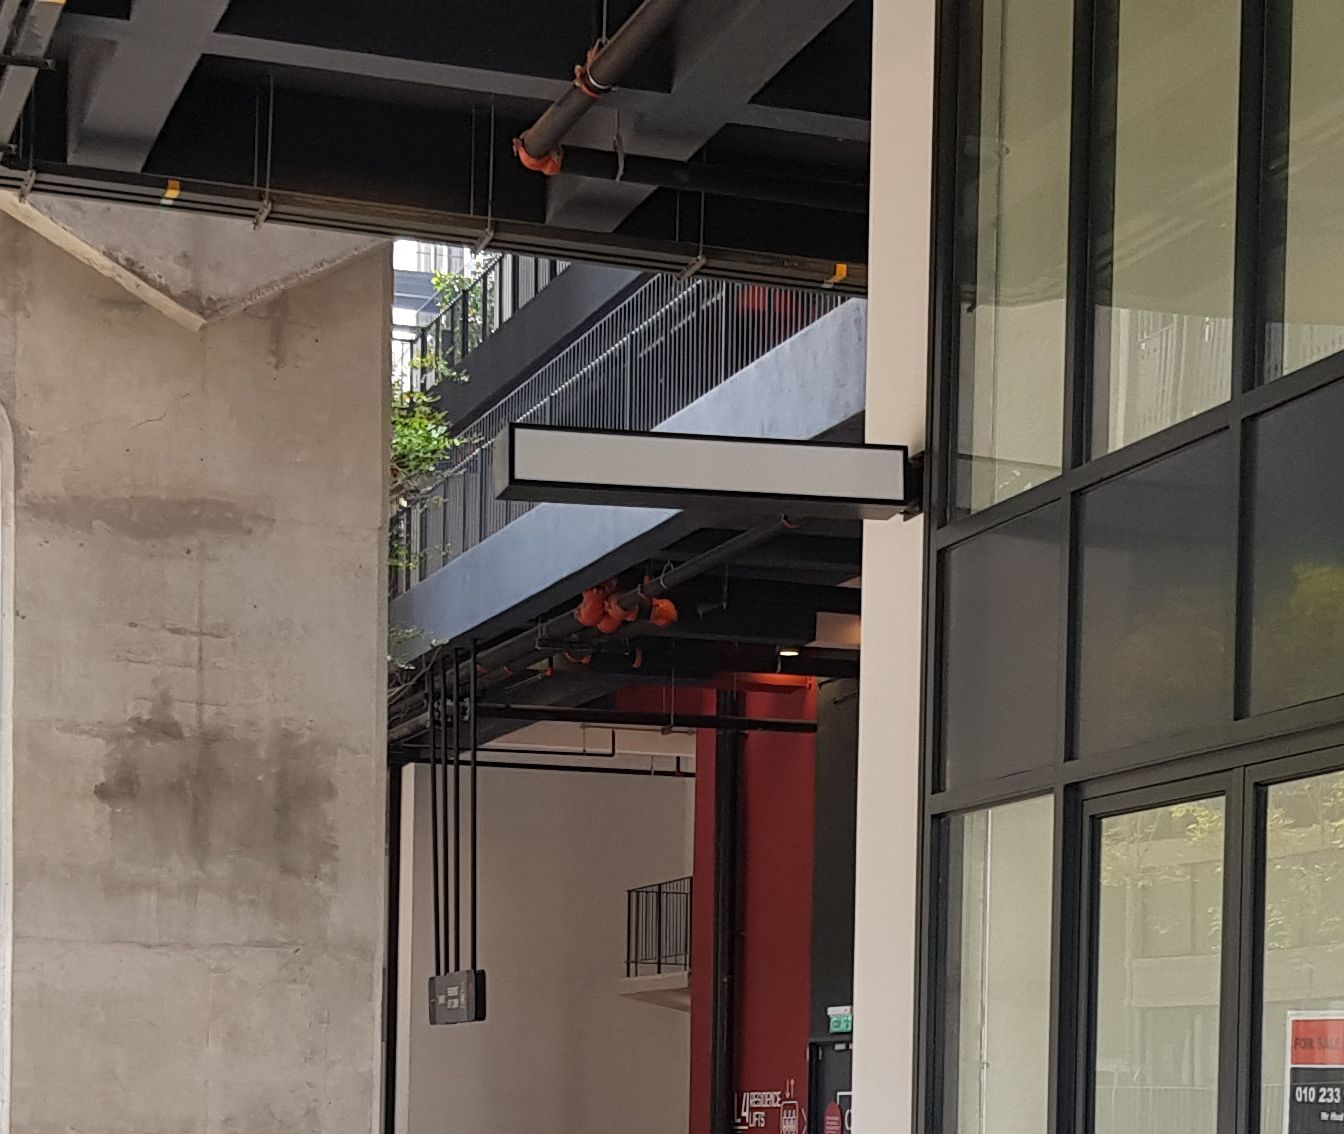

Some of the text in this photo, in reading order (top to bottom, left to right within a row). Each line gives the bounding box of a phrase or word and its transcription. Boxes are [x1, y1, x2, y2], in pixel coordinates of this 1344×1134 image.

[1293, 1037, 1313, 1049] FOR
[1317, 1037, 1342, 1049] SALE
[1295, 1086, 1316, 1103] 010
[1318, 1086, 1341, 1104] 233
[1321, 1112, 1329, 1120] Mr
